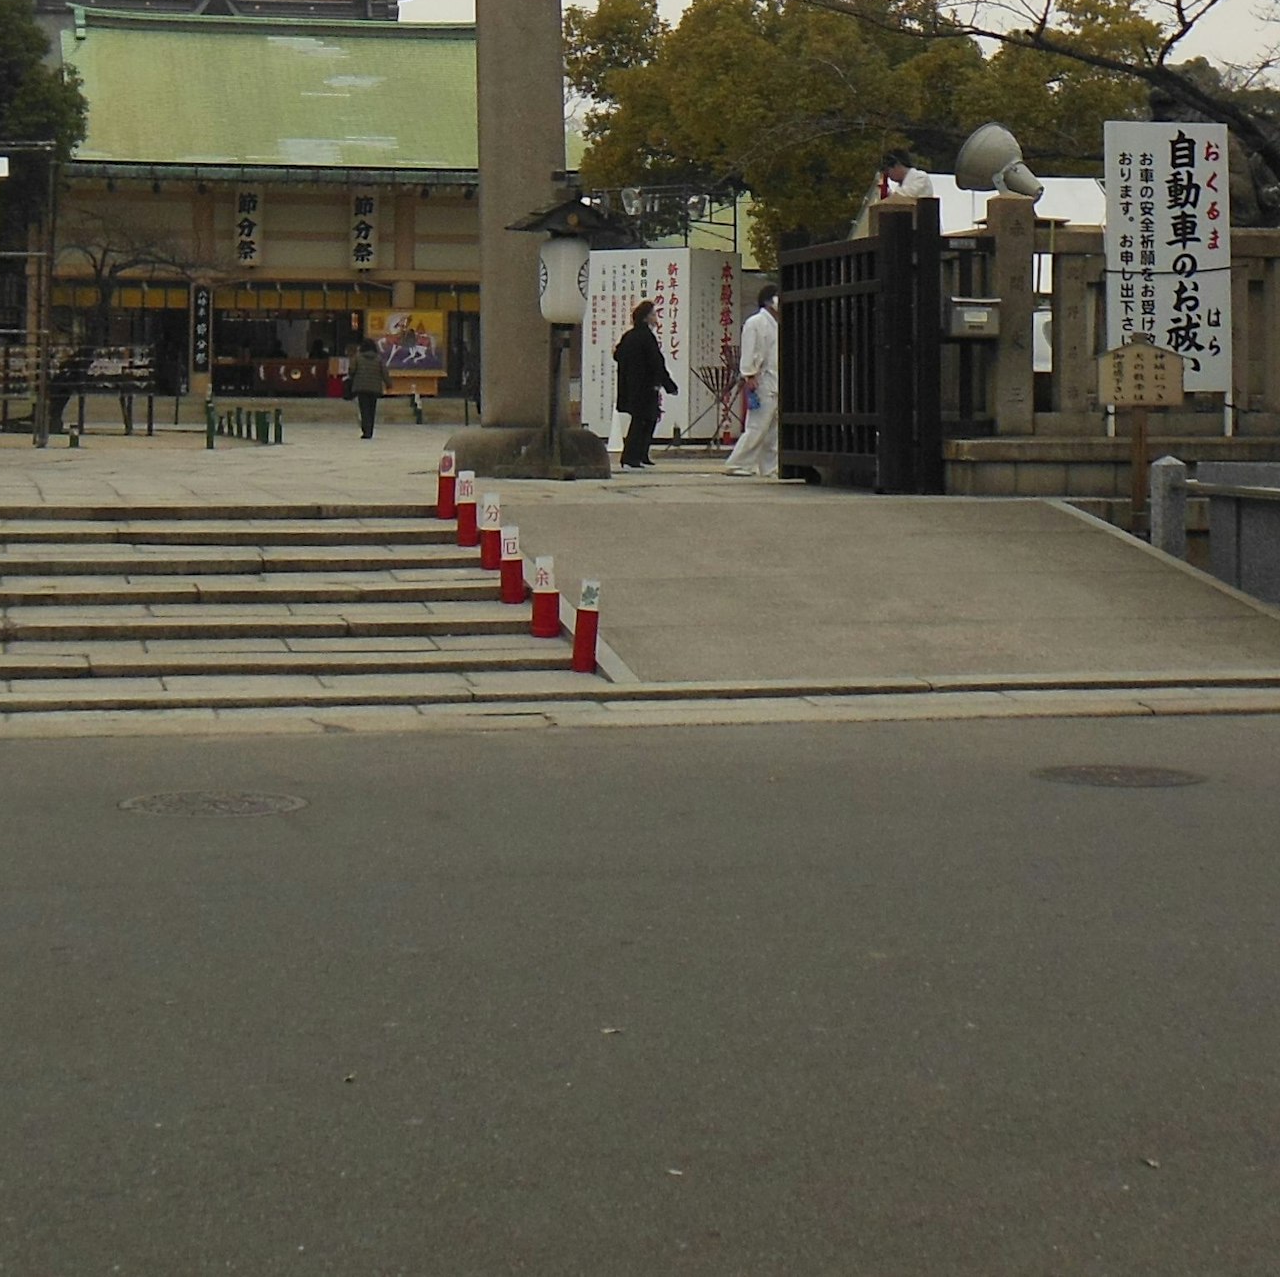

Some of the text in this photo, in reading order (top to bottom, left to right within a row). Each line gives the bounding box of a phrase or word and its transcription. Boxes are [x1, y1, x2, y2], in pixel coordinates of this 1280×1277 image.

[238, 192, 258, 260] 節分祭
[1204, 140, 1221, 250] おくるま
[352, 196, 374, 263] 節分祭
[667, 262, 681, 361] 新年あけまして
[1206, 307, 1221, 357] はら
[485, 504, 500, 522] 分
